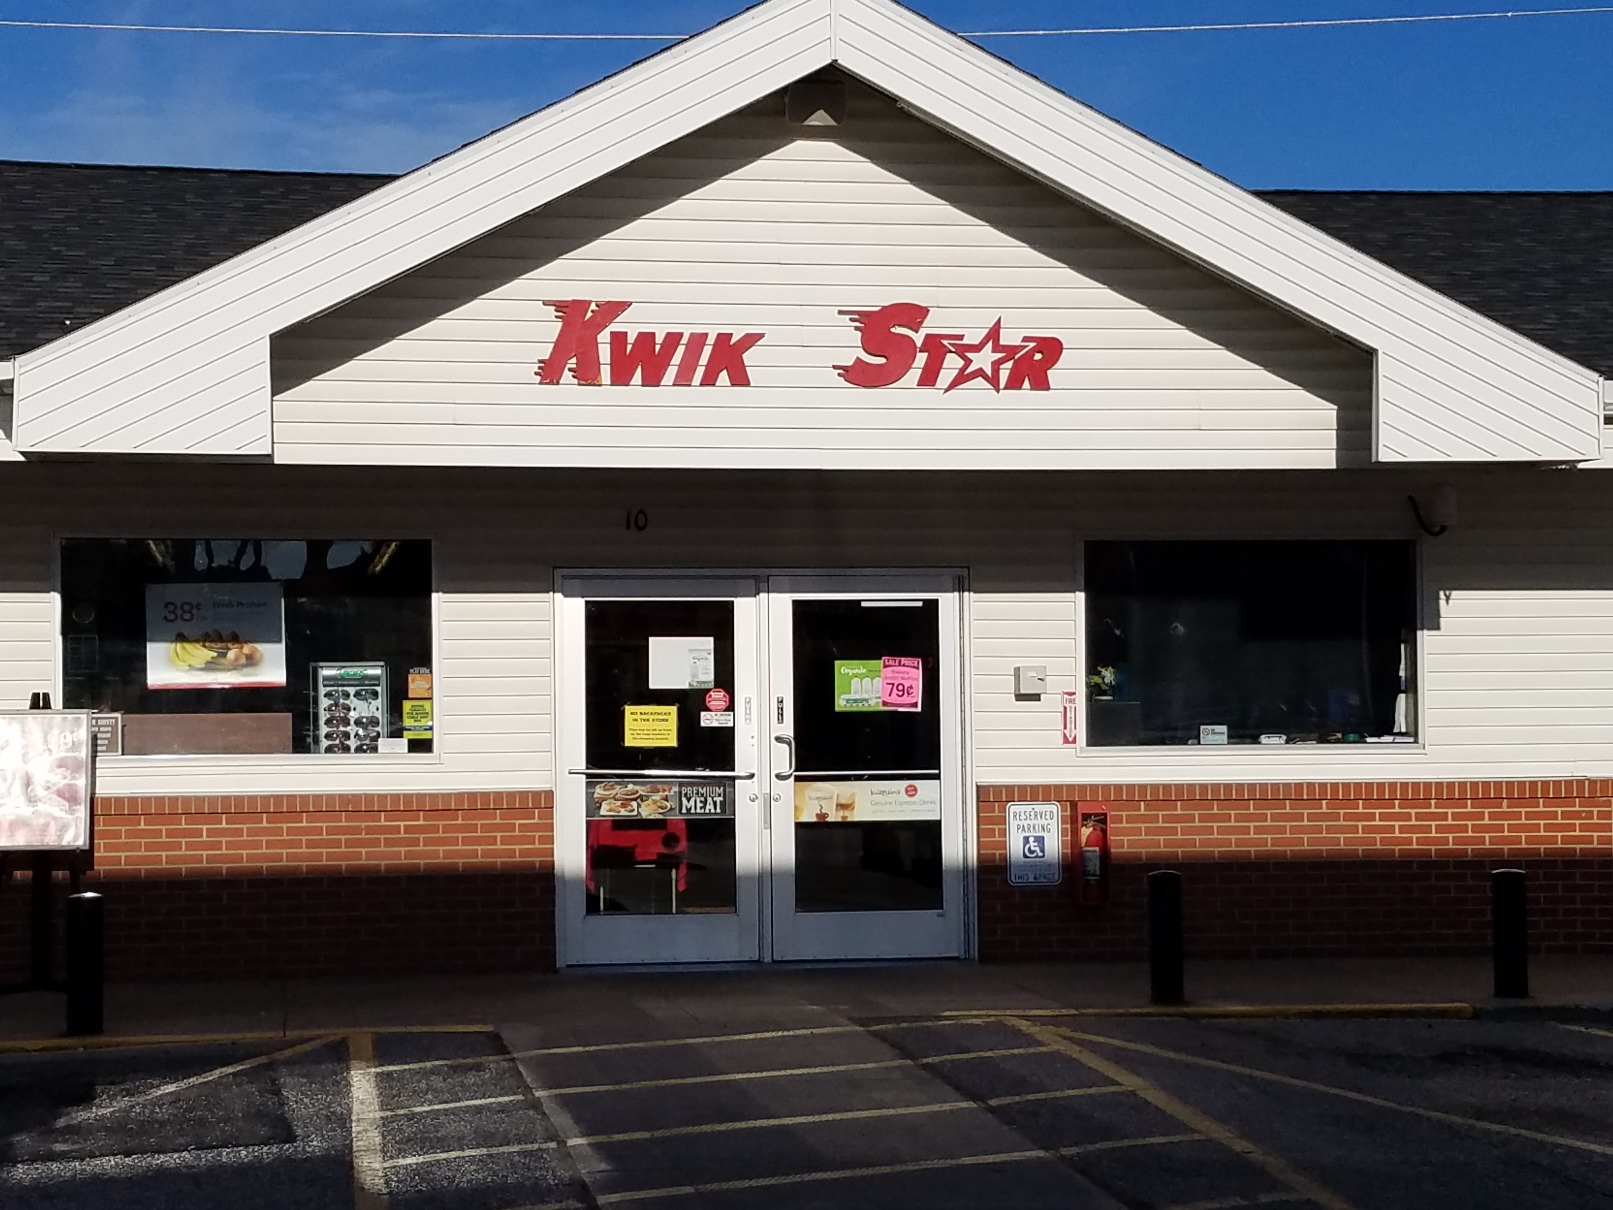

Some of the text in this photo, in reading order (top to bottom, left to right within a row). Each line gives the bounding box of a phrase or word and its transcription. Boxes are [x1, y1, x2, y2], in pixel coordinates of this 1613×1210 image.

[626, 508, 648, 531] 10
[681, 786, 724, 797] PREMIUM
[681, 797, 723, 814] MEAT
[1012, 810, 1055, 821] RESERVED
[1016, 823, 1052, 834] PARKING
